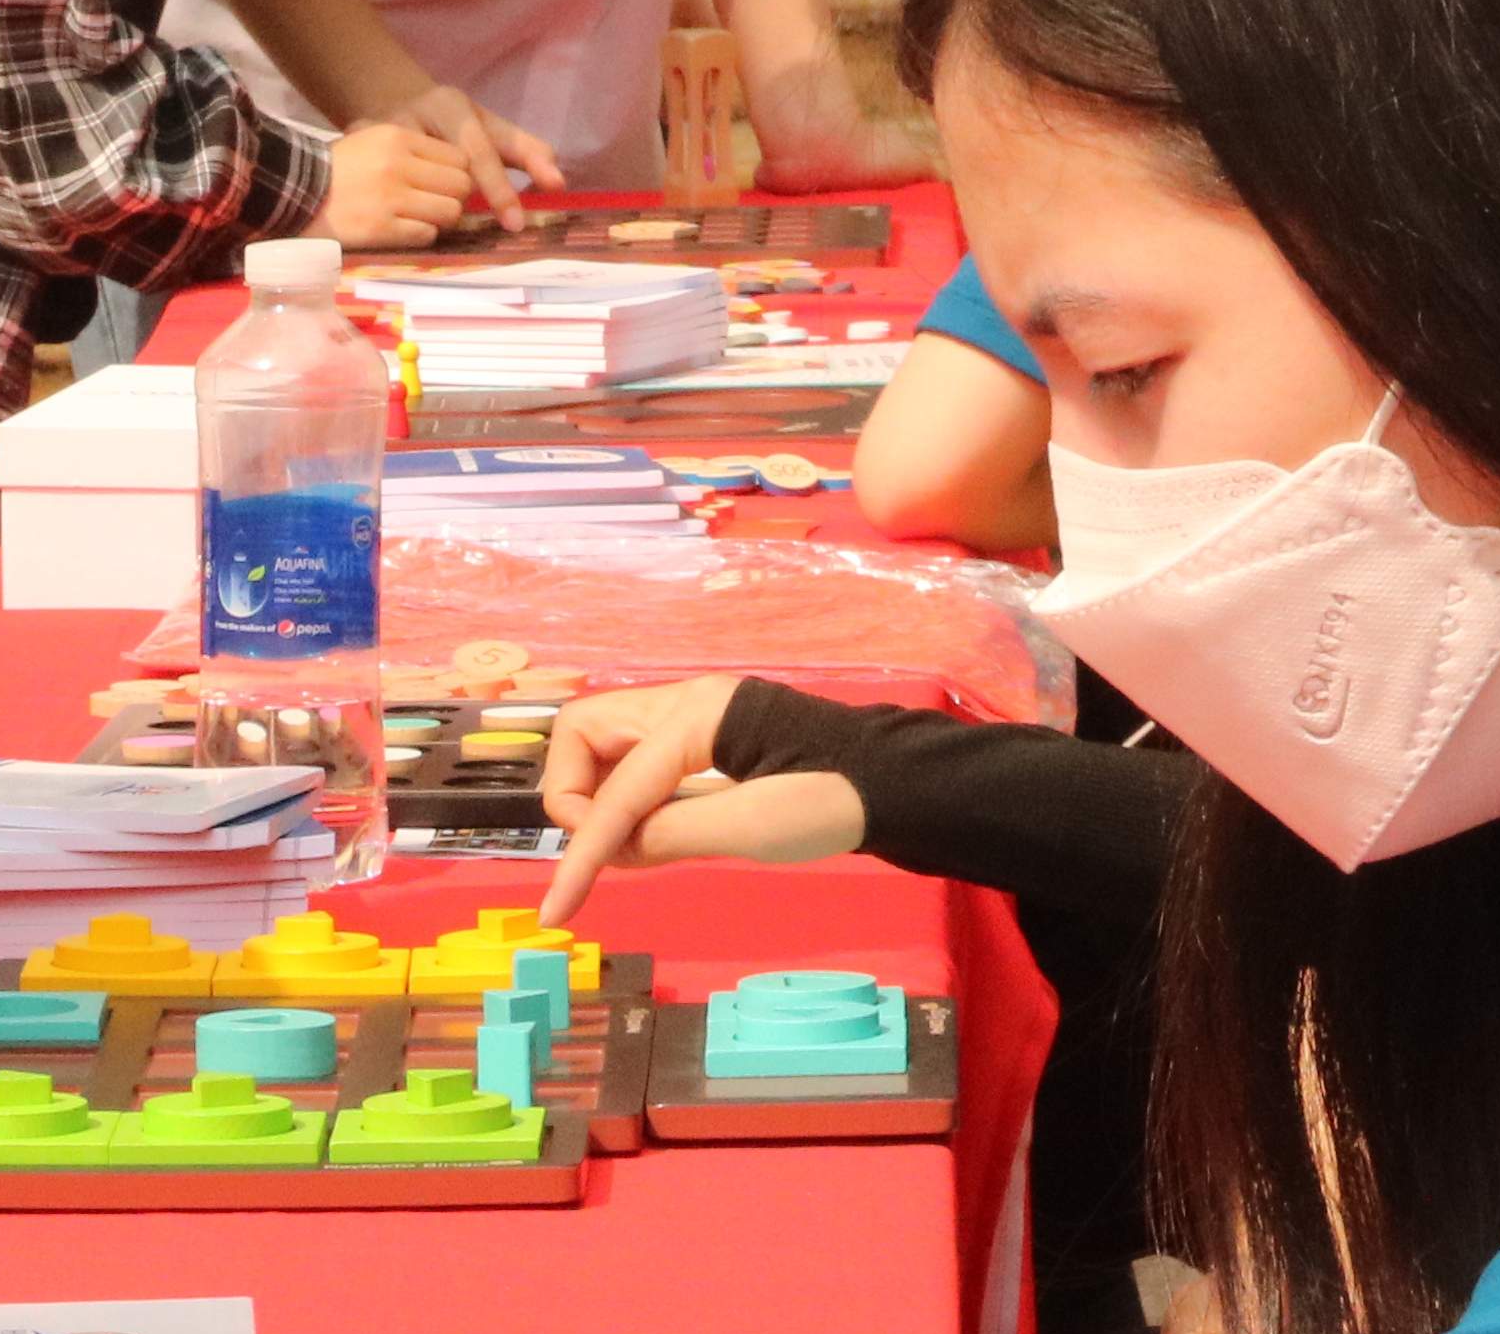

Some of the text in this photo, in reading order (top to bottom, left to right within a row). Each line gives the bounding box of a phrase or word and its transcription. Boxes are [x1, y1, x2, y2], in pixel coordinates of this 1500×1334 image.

[274, 557, 326, 574] AQUAFINA
[296, 623, 332, 637] pepsi
[473, 647, 509, 666] 5
